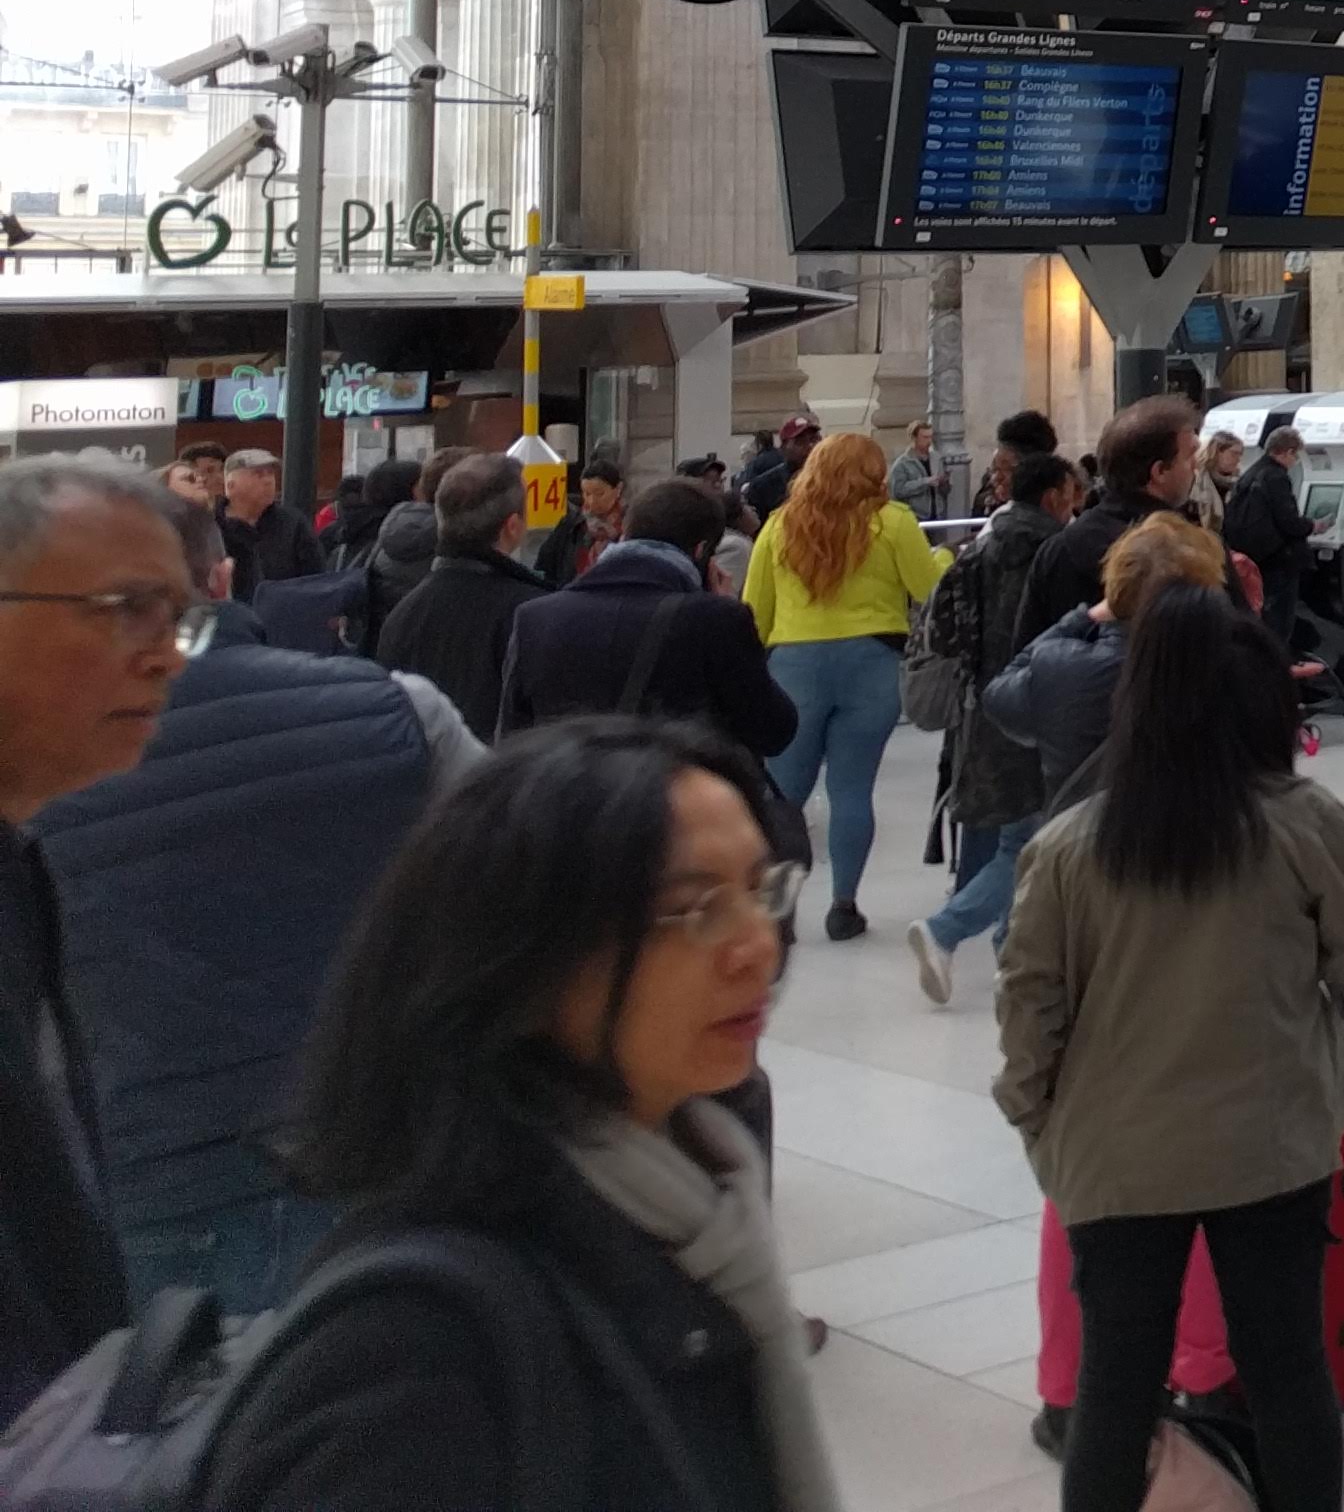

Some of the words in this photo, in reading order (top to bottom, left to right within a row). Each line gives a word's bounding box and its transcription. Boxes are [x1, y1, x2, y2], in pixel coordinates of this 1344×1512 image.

[936, 29, 985, 46] Départs
[987, 31, 1036, 45] Grandes
[1038, 33, 1076, 48] Lignes
[1017, 95, 1046, 109] Rang
[1048, 96, 1061, 106] du
[1062, 96, 1091, 108] Fliers
[1092, 97, 1128, 109] Verton
[1015, 110, 1074, 124] Dunkerque
[1014, 125, 1072, 139] Dunkerque
[1012, 140, 1082, 152] Valenciennes
[1283, 76, 1320, 216] information
[1009, 154, 1058, 167] Bruxelles
[1060, 156, 1085, 168] Midi
[1007, 169, 1049, 182] Amiens
[1006, 185, 1047, 197] Amiens
[1004, 199, 1051, 211] Beauvais
[341, 199, 512, 271] PLACE
[31, 403, 166, 424] Photomaton
